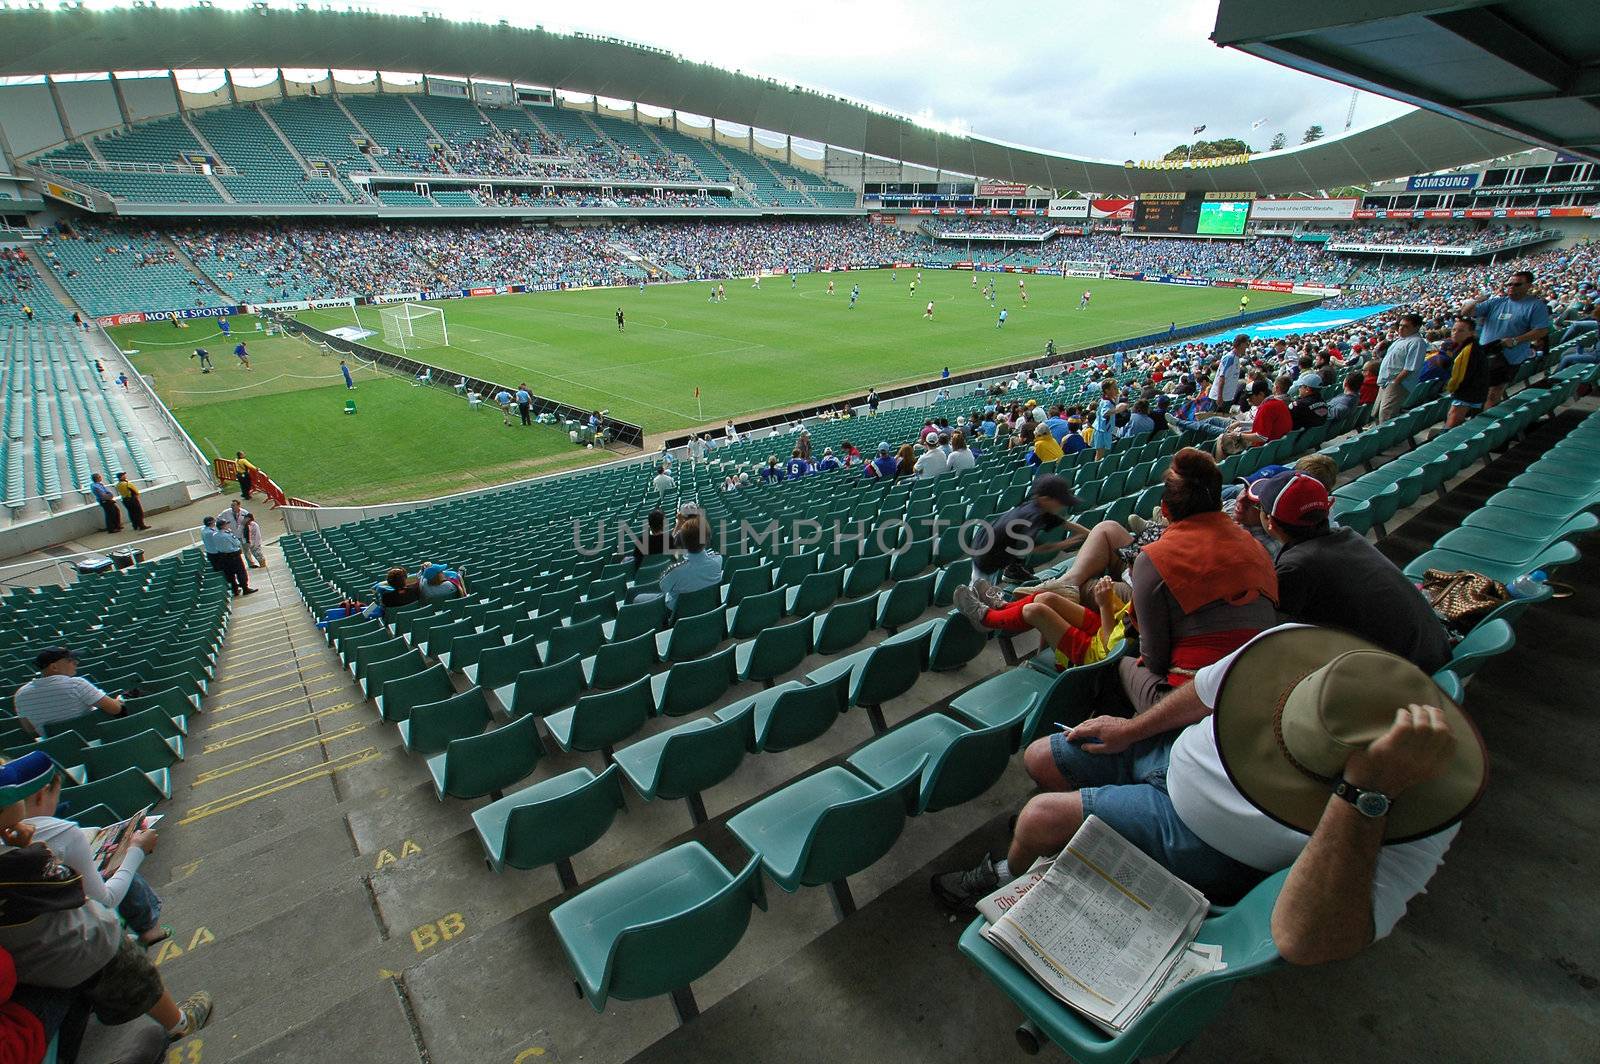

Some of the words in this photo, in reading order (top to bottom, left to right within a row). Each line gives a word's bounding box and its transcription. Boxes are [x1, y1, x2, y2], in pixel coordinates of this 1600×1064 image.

[1138, 160, 1184, 170] AUSSIE
[1190, 154, 1250, 169] STADIUM
[1414, 177, 1469, 188] SAMSUNG
[316, 301, 351, 309] QANTAS
[145, 310, 188, 322] MOORE
[190, 307, 230, 319] SPORTS
[791, 463, 799, 474] 6
[374, 838, 423, 870] AA
[994, 895, 1019, 910] The
[410, 911, 466, 953] BB
[153, 926, 216, 966] AA
